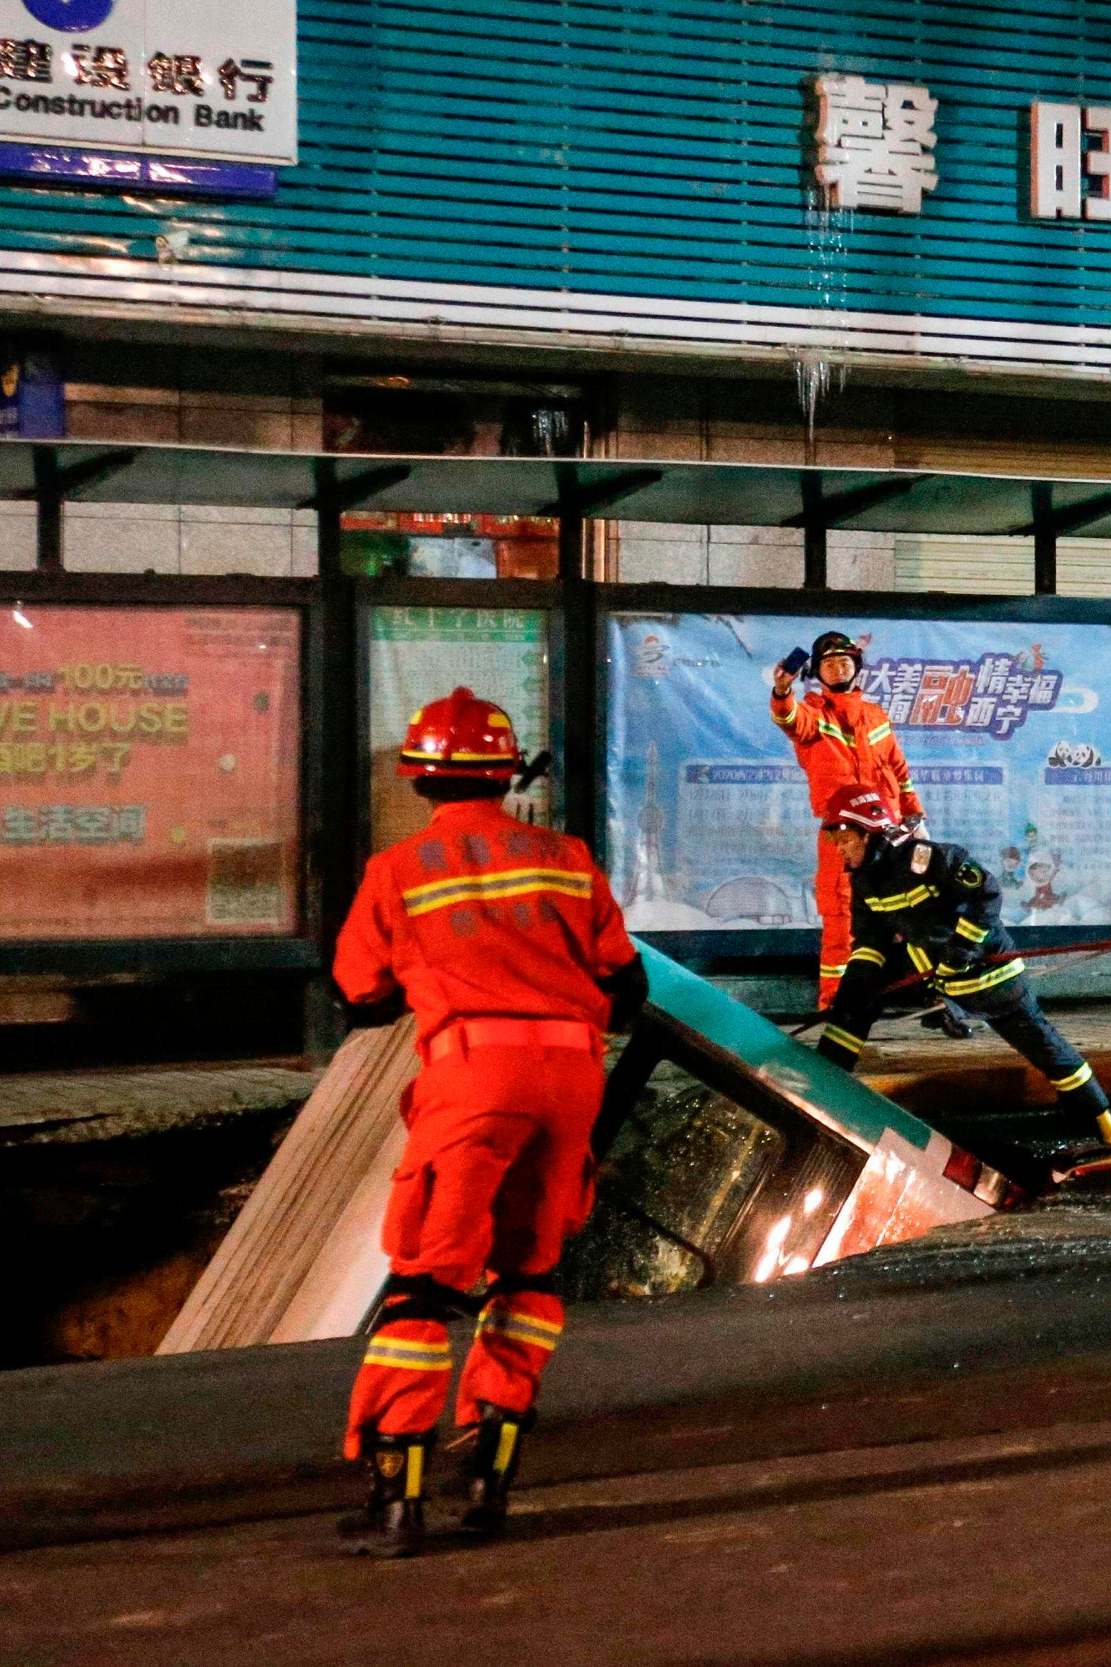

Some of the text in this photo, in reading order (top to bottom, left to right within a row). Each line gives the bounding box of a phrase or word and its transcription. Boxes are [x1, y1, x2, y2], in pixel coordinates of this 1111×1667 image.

[194, 104, 265, 132] Bank
[48, 701, 189, 733] HOUSE
[3, 805, 146, 839] 生活空间
